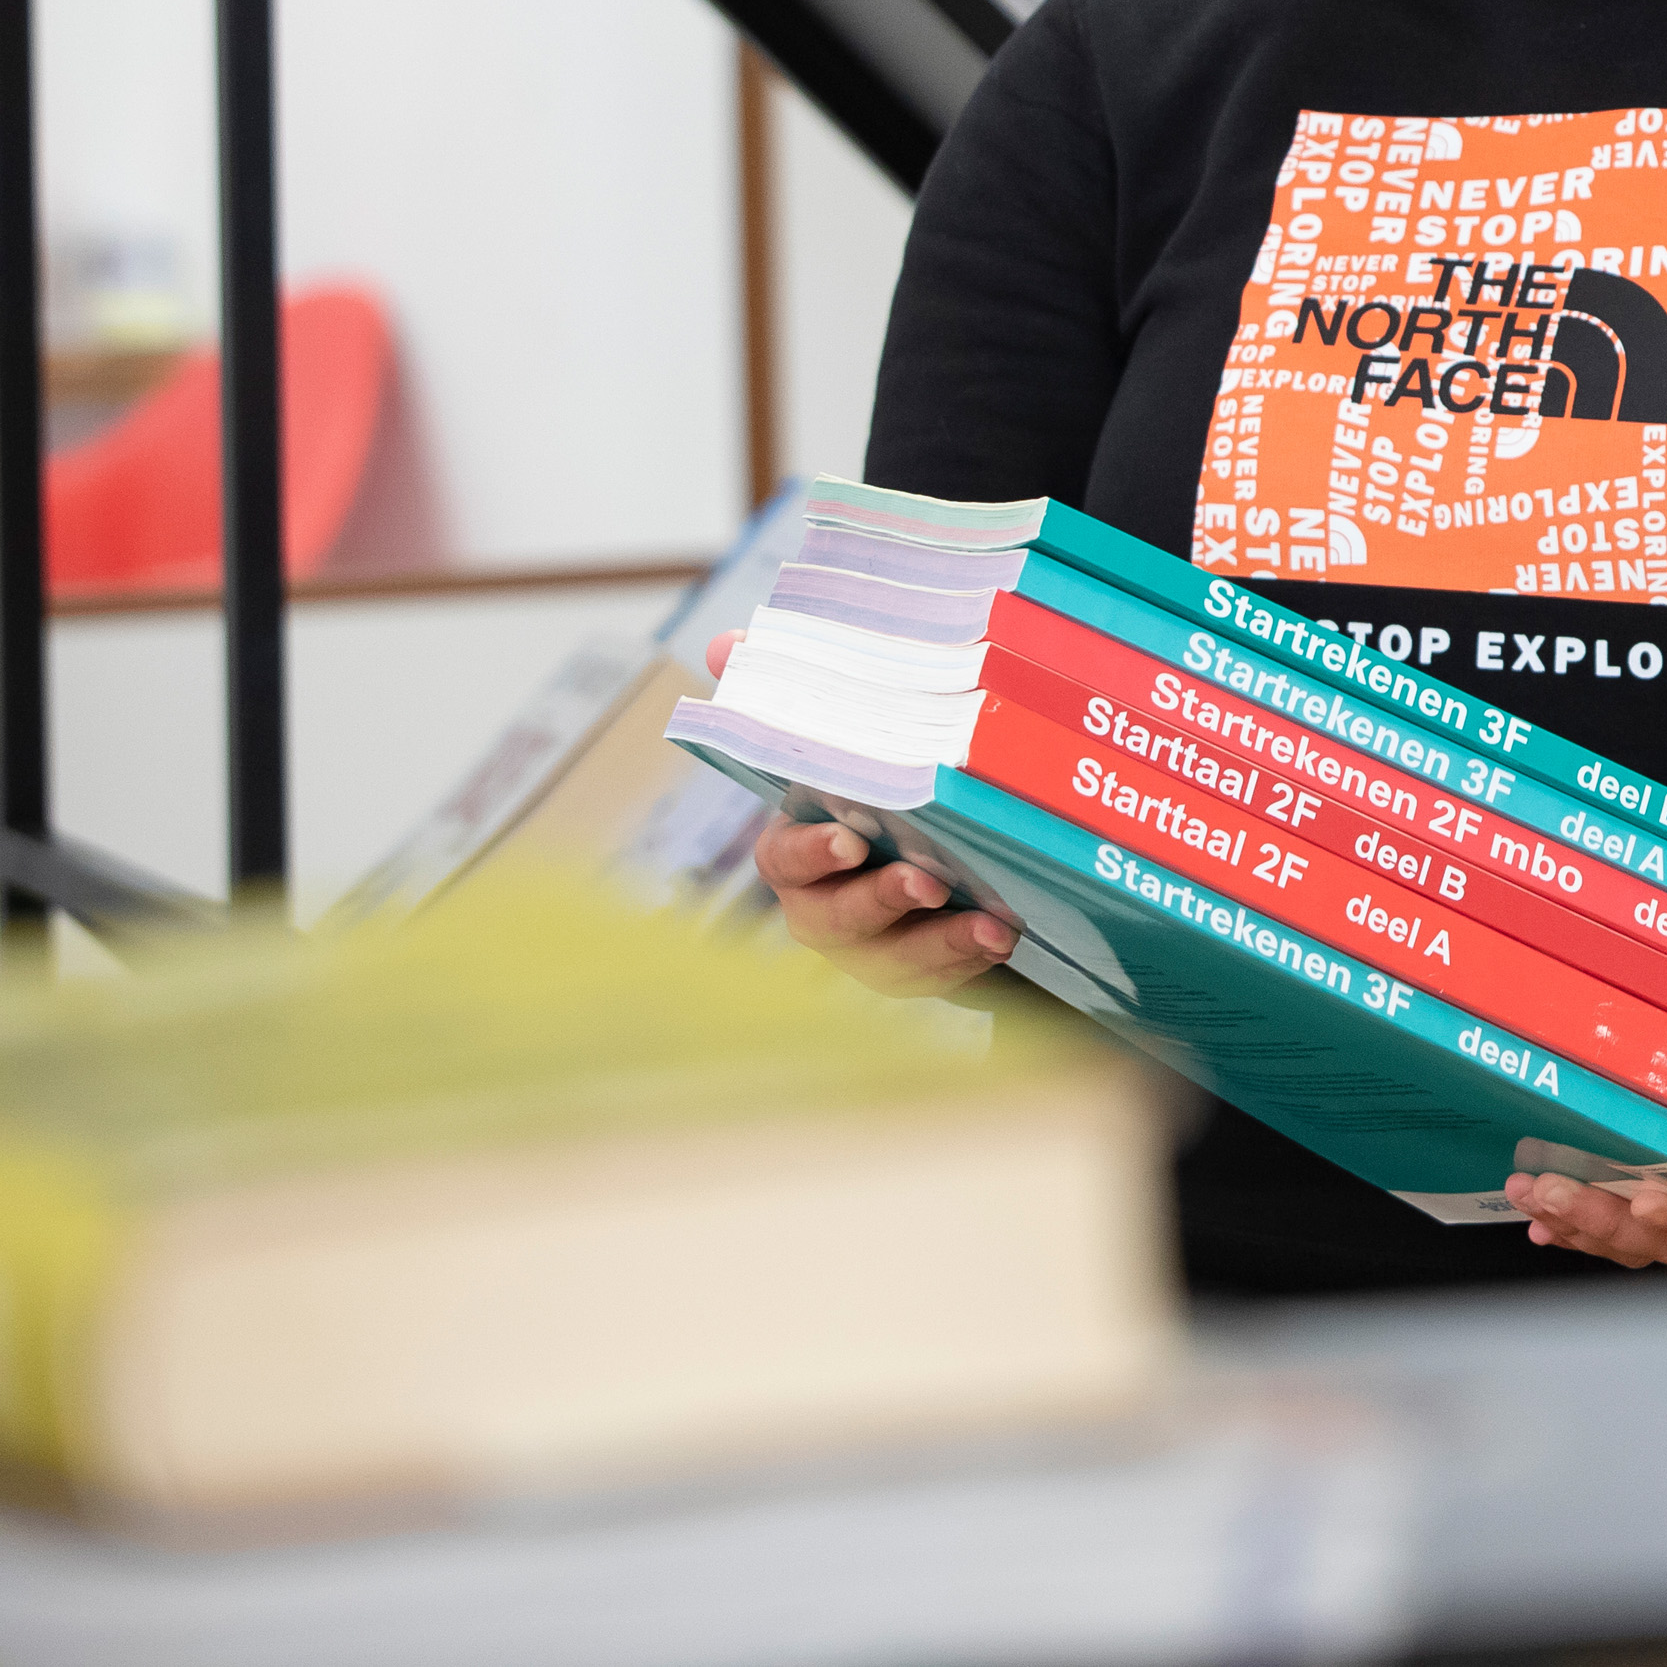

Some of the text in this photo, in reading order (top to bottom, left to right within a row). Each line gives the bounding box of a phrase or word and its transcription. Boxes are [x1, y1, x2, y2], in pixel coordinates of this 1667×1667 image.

[1334, 117, 1386, 212] STOP
[1369, 117, 1429, 244] NEVER
[1419, 166, 1595, 211] NEVER
[1264, 112, 1344, 338] EXPLORING
[1315, 254, 1399, 273] NEVER
[1414, 209, 1555, 247] STOP
[1311, 274, 1377, 293] STOP
[1428, 257, 1566, 309] THE
[1292, 297, 1552, 361] NORTH
[1351, 353, 1539, 416] FACE
[1211, 397, 1238, 480] STOP
[1233, 394, 1265, 501] NEVER
[1328, 397, 1373, 517] NEVER
[1362, 435, 1403, 526] STOP
[1433, 476, 1639, 531] EXPLORING
[1537, 518, 1641, 556] STOP
[1515, 559, 1647, 593] NEVER
[1316, 618, 1452, 665] TOP
[1203, 577, 1470, 732] Startrekenen
[1478, 707, 1533, 755] 3F
[1576, 761, 1654, 811] deel
[1082, 696, 1469, 903] Starttaal 2F deel B
[1150, 671, 1420, 822] Startrekenen
[1427, 799, 1483, 844] 2F
[1489, 832, 1585, 896] mbo
[1183, 631, 1666, 883] Startrekenen 3F deel A
[1071, 757, 1452, 967] Starttaal 2F deel A
[1094, 842, 1560, 1097] Startrekenen 3F deel A
